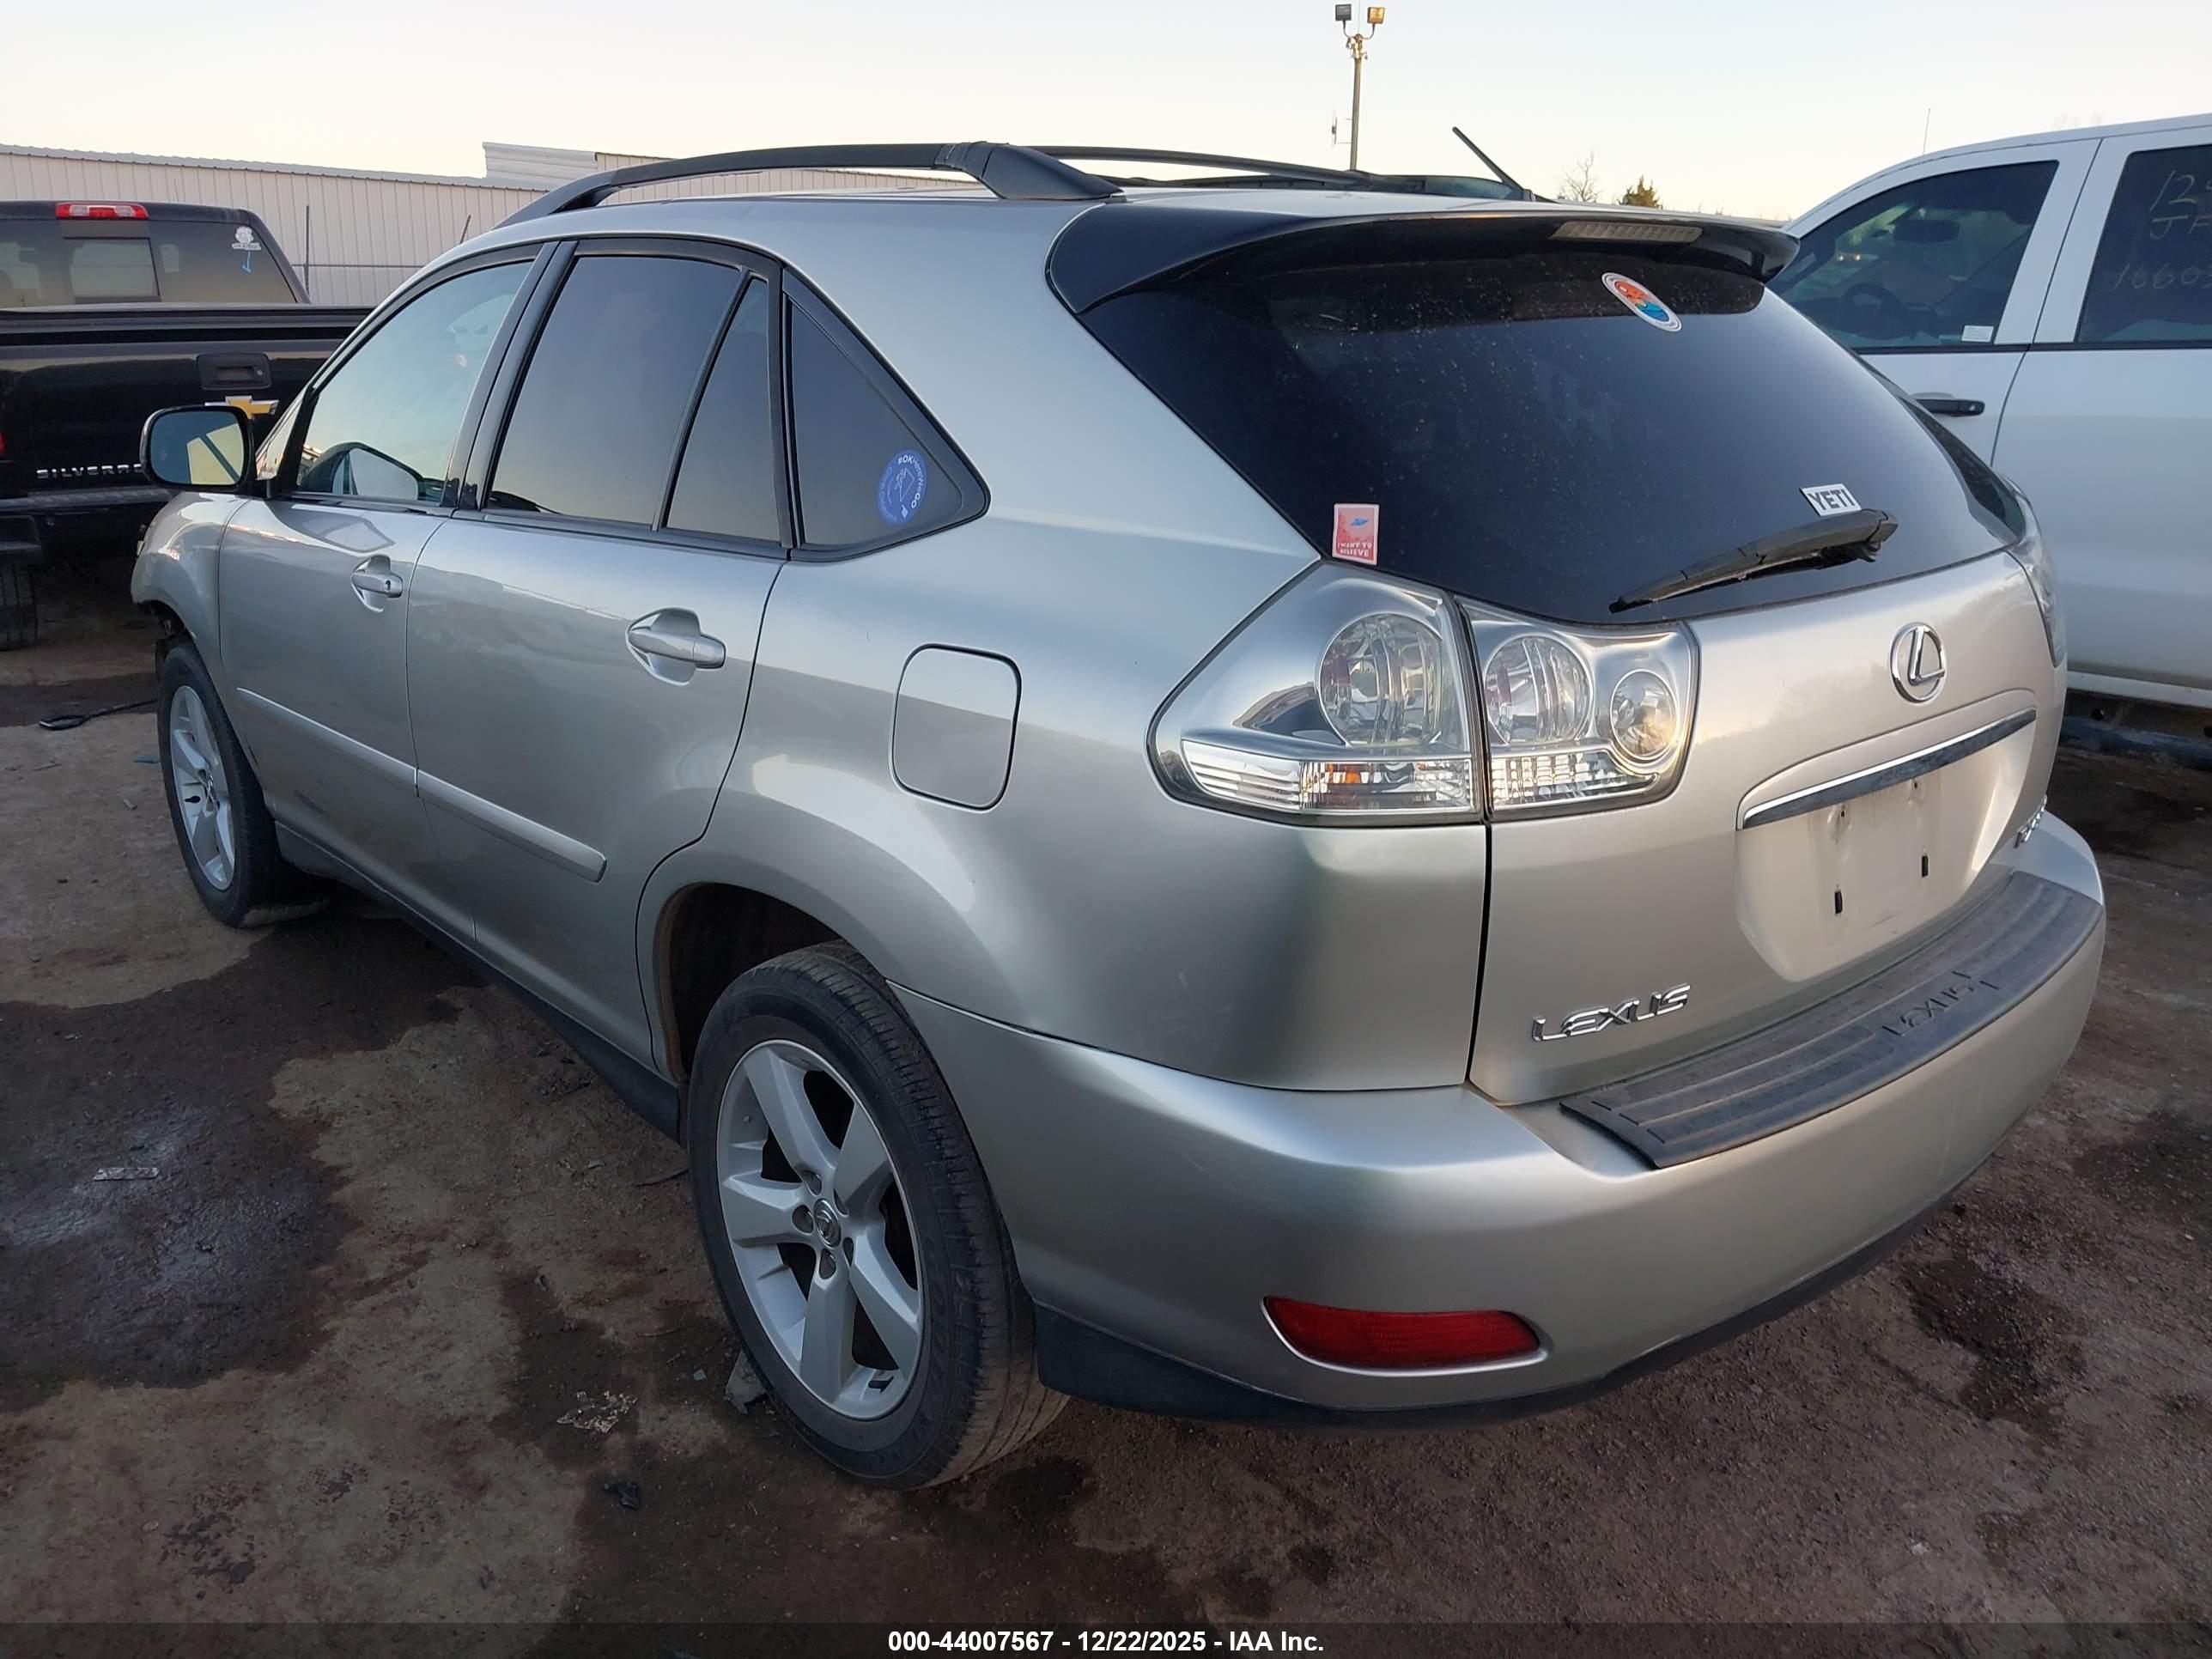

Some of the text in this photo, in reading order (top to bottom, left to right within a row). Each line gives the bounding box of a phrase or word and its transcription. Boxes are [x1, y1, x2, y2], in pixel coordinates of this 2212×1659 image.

[1807, 489, 1856, 511] YETI
[1340, 548, 1369, 557] BELIEVE
[1532, 982, 1691, 1042] LEXUS
